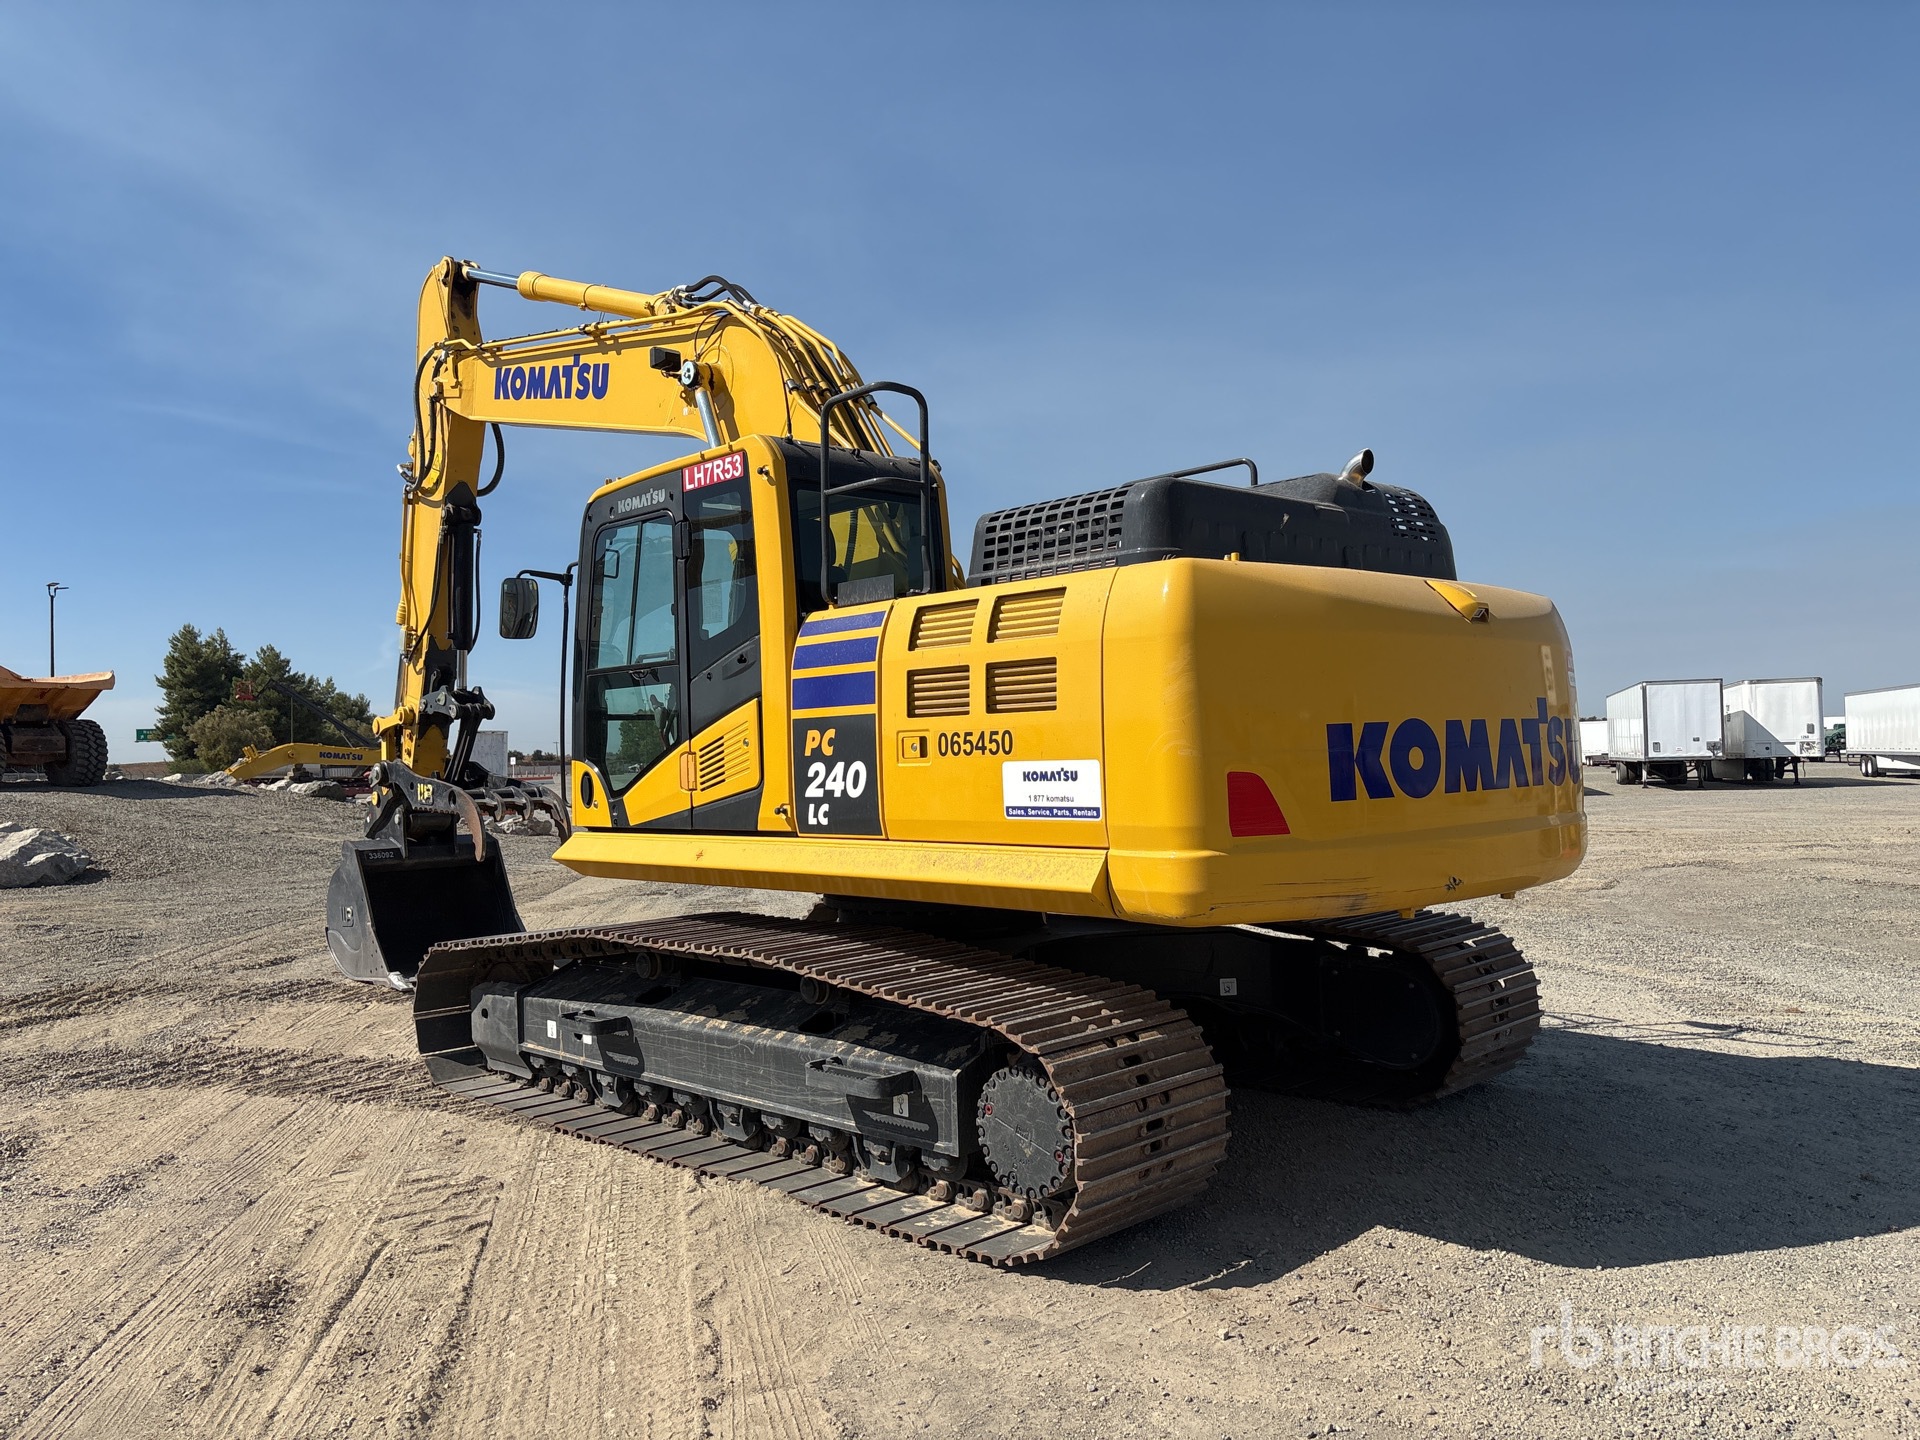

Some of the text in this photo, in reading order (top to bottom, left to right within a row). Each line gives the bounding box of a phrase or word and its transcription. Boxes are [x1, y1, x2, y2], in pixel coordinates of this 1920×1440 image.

[494, 354, 609, 400] KOMATSU
[685, 454, 742, 490] LH7R53
[618, 488, 666, 514] KOMATSU
[319, 751, 363, 761] KOMATSU
[804, 728, 836, 757] PC
[938, 729, 1013, 757] 065450
[804, 760, 867, 798] 240
[1022, 767, 1078, 782] KOMATSU
[808, 803, 829, 825] LC
[1008, 808, 1097, 817] Sales, Service, Parts, Rentals
